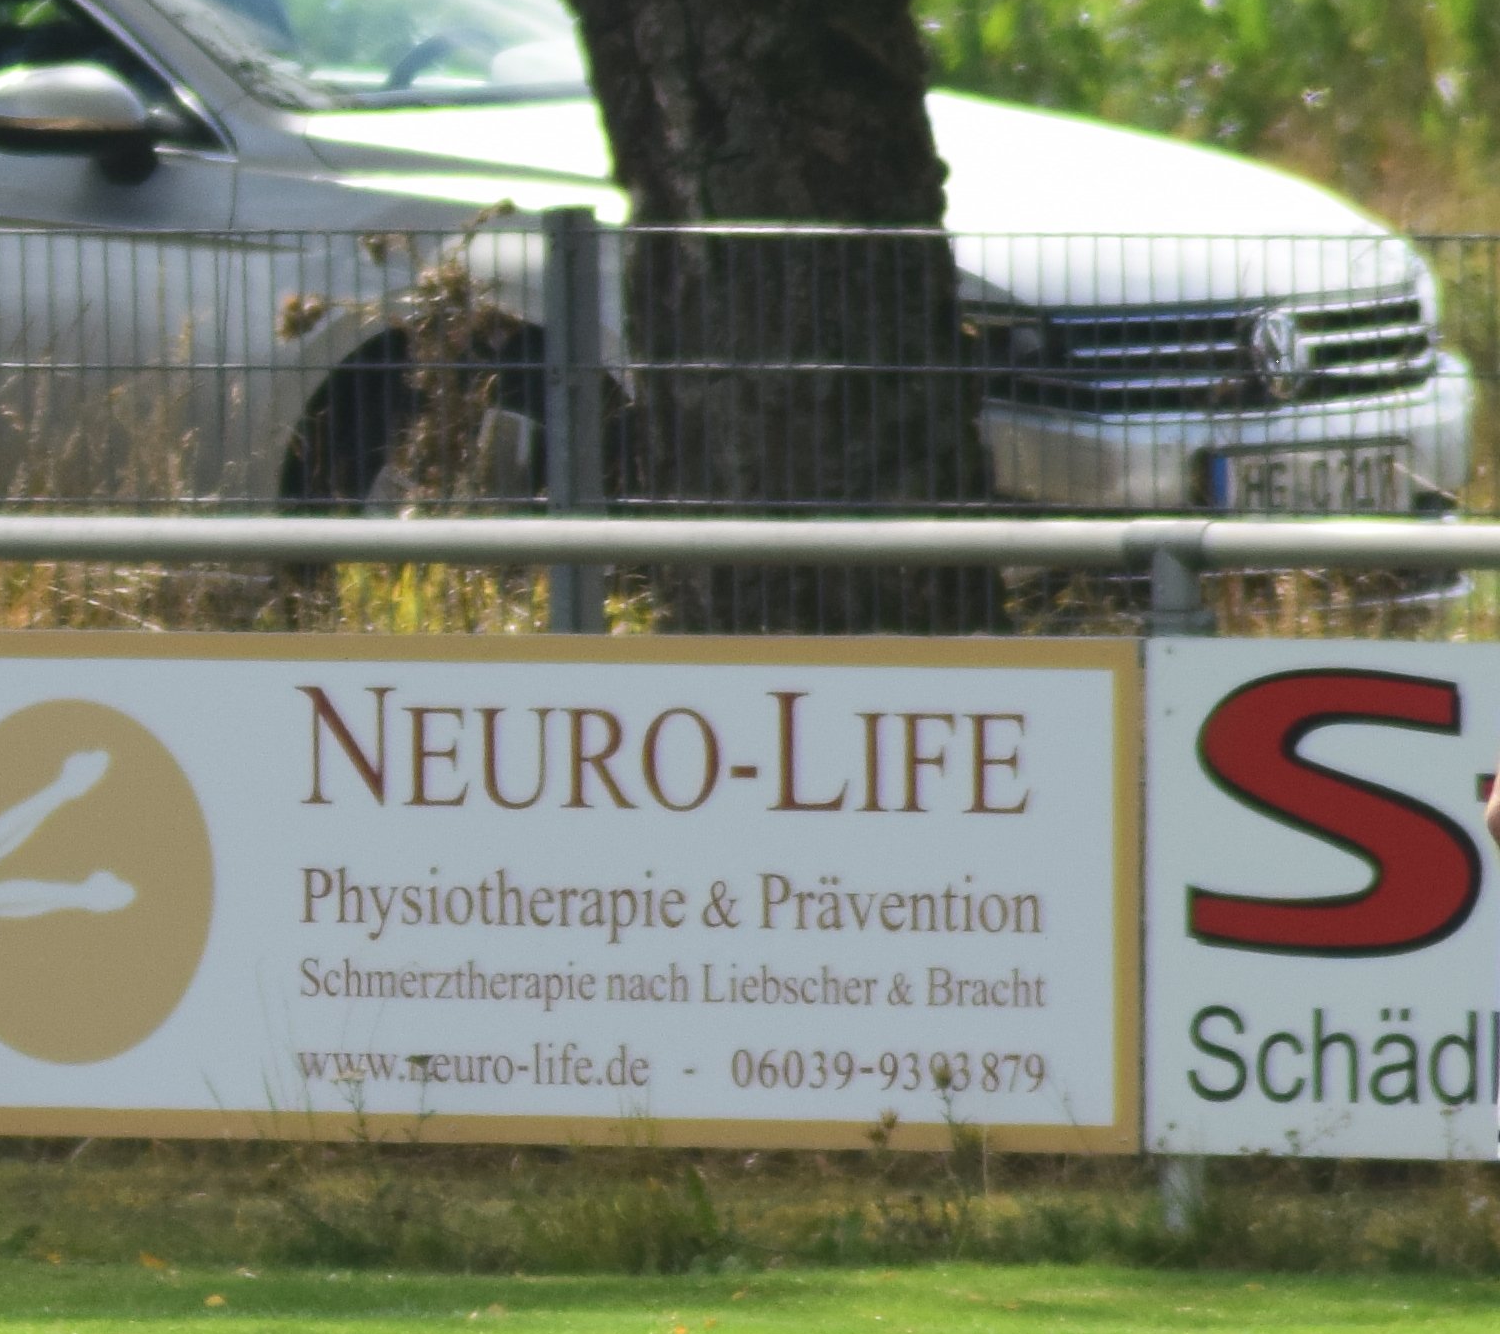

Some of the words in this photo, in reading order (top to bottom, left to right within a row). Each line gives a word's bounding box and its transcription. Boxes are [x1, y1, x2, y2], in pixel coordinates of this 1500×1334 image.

[299, 867, 687, 944] Physiotherapie
[701, 879, 740, 929] &
[757, 872, 1044, 934] Prävention
[299, 958, 597, 1012] Schmerztherapie
[606, 962, 691, 1004] nach
[701, 962, 877, 1008] Liebscher
[887, 969, 916, 1008] &
[924, 965, 1047, 1010] Bracht
[297, 1042, 651, 1088] www.neuro-life.de
